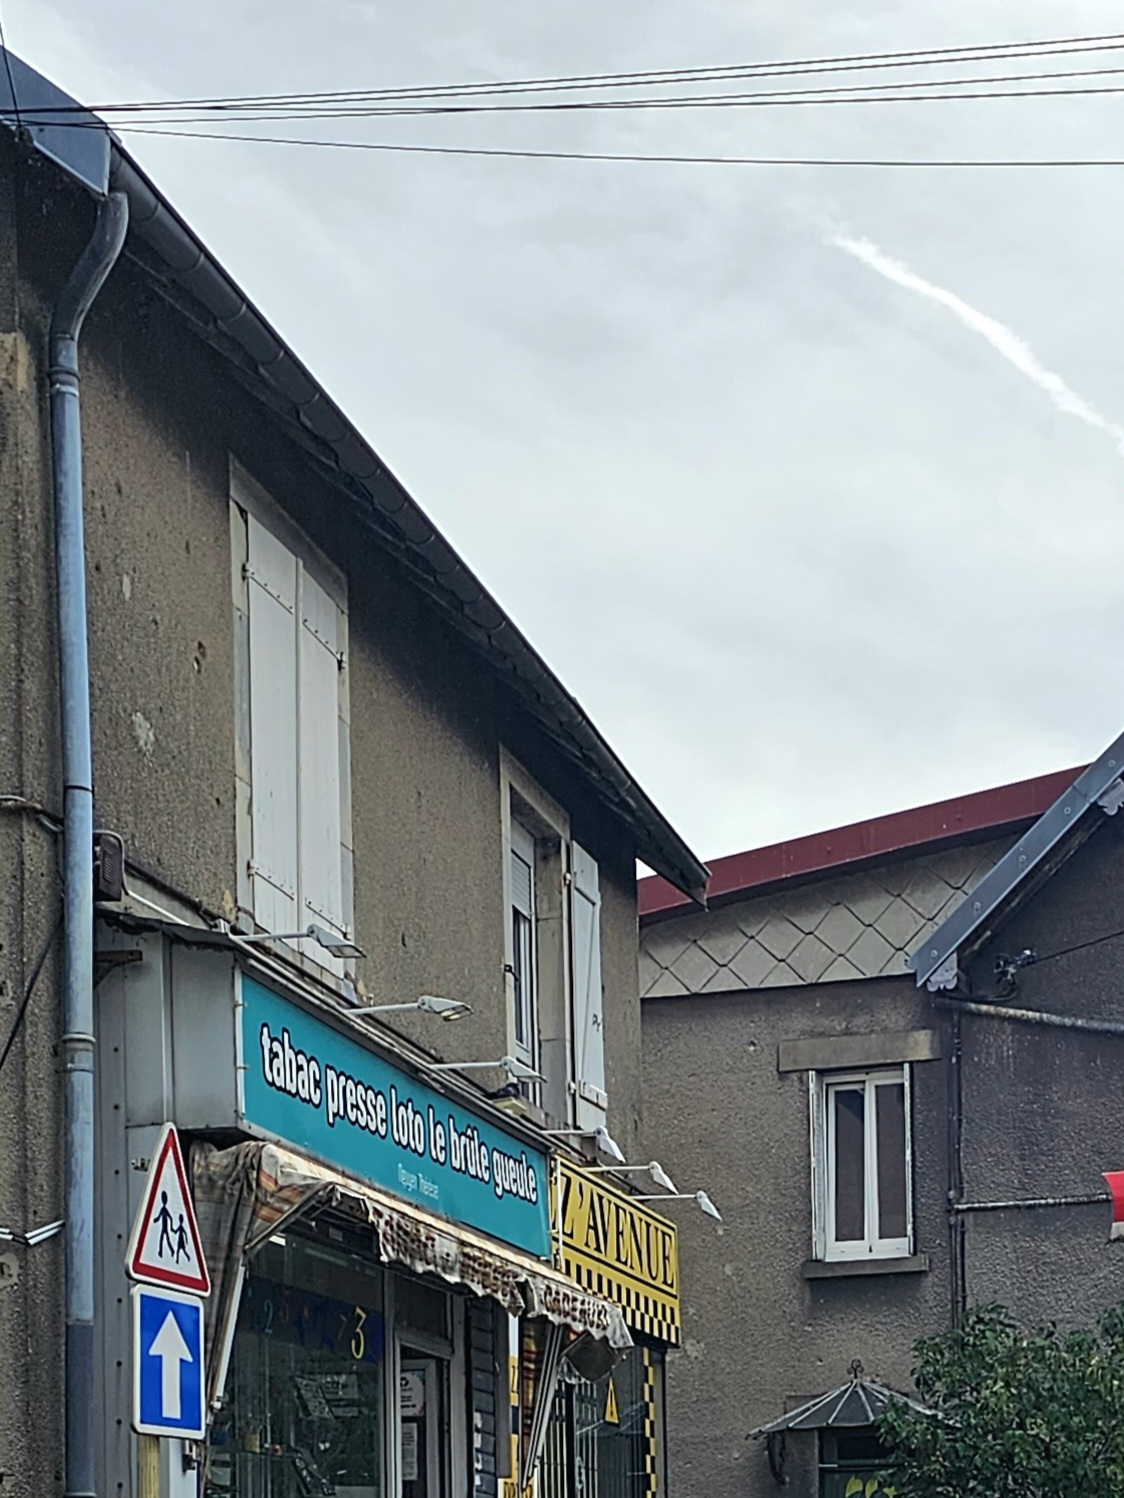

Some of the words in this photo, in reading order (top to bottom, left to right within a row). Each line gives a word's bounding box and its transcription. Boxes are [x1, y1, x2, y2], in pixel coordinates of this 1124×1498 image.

[260, 1022, 322, 1109] tabac
[325, 1063, 388, 1140] presse
[390, 1084, 426, 1157] loto
[427, 1104, 447, 1165] le
[448, 1114, 491, 1184] brûle
[492, 1147, 538, 1205] gueule
